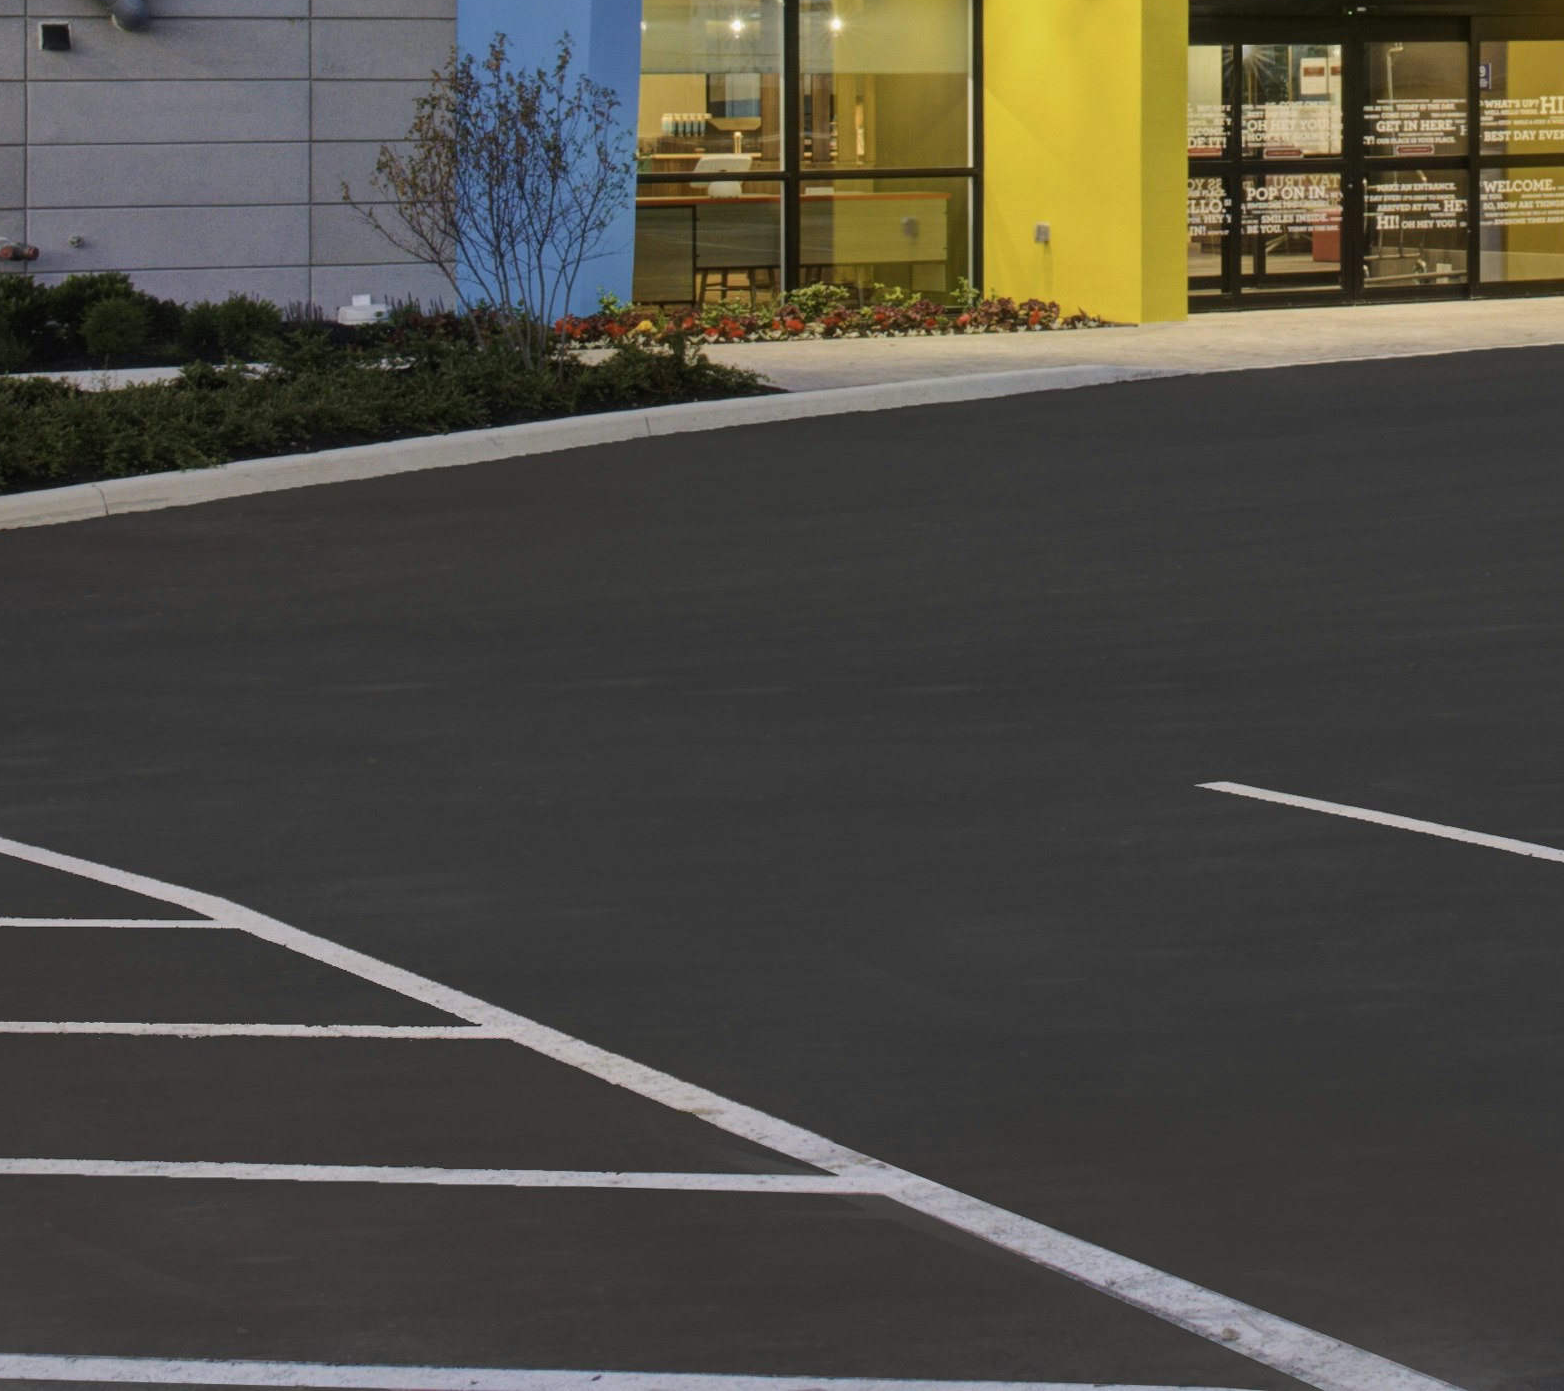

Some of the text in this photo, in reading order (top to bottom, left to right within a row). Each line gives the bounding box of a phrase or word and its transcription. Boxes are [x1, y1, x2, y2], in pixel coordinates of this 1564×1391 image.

[1484, 99, 1539, 108] WHAT'S UP?
[1247, 120, 1268, 131] OH
[1271, 119, 1296, 130] HEY
[1377, 120, 1402, 132] GET
[1404, 120, 1418, 131] IN
[1420, 119, 1456, 131] HERE.
[1484, 131, 1512, 142] BEST
[1513, 130, 1536, 141] DAY
[1483, 179, 1556, 193] WELCOME.
[1247, 185, 1329, 201] POP ON IN.
[1483, 202, 1496, 210] SO,
[1497, 201, 1518, 210] HOW
[1518, 200, 1534, 209] ARE
[1261, 214, 1294, 224] SMILES
[1296, 213, 1329, 223] INSIDE.
[1377, 215, 1400, 229] HI!
[1417, 220, 1434, 228] HEY
[1247, 224, 1283, 234] BE YOU.
